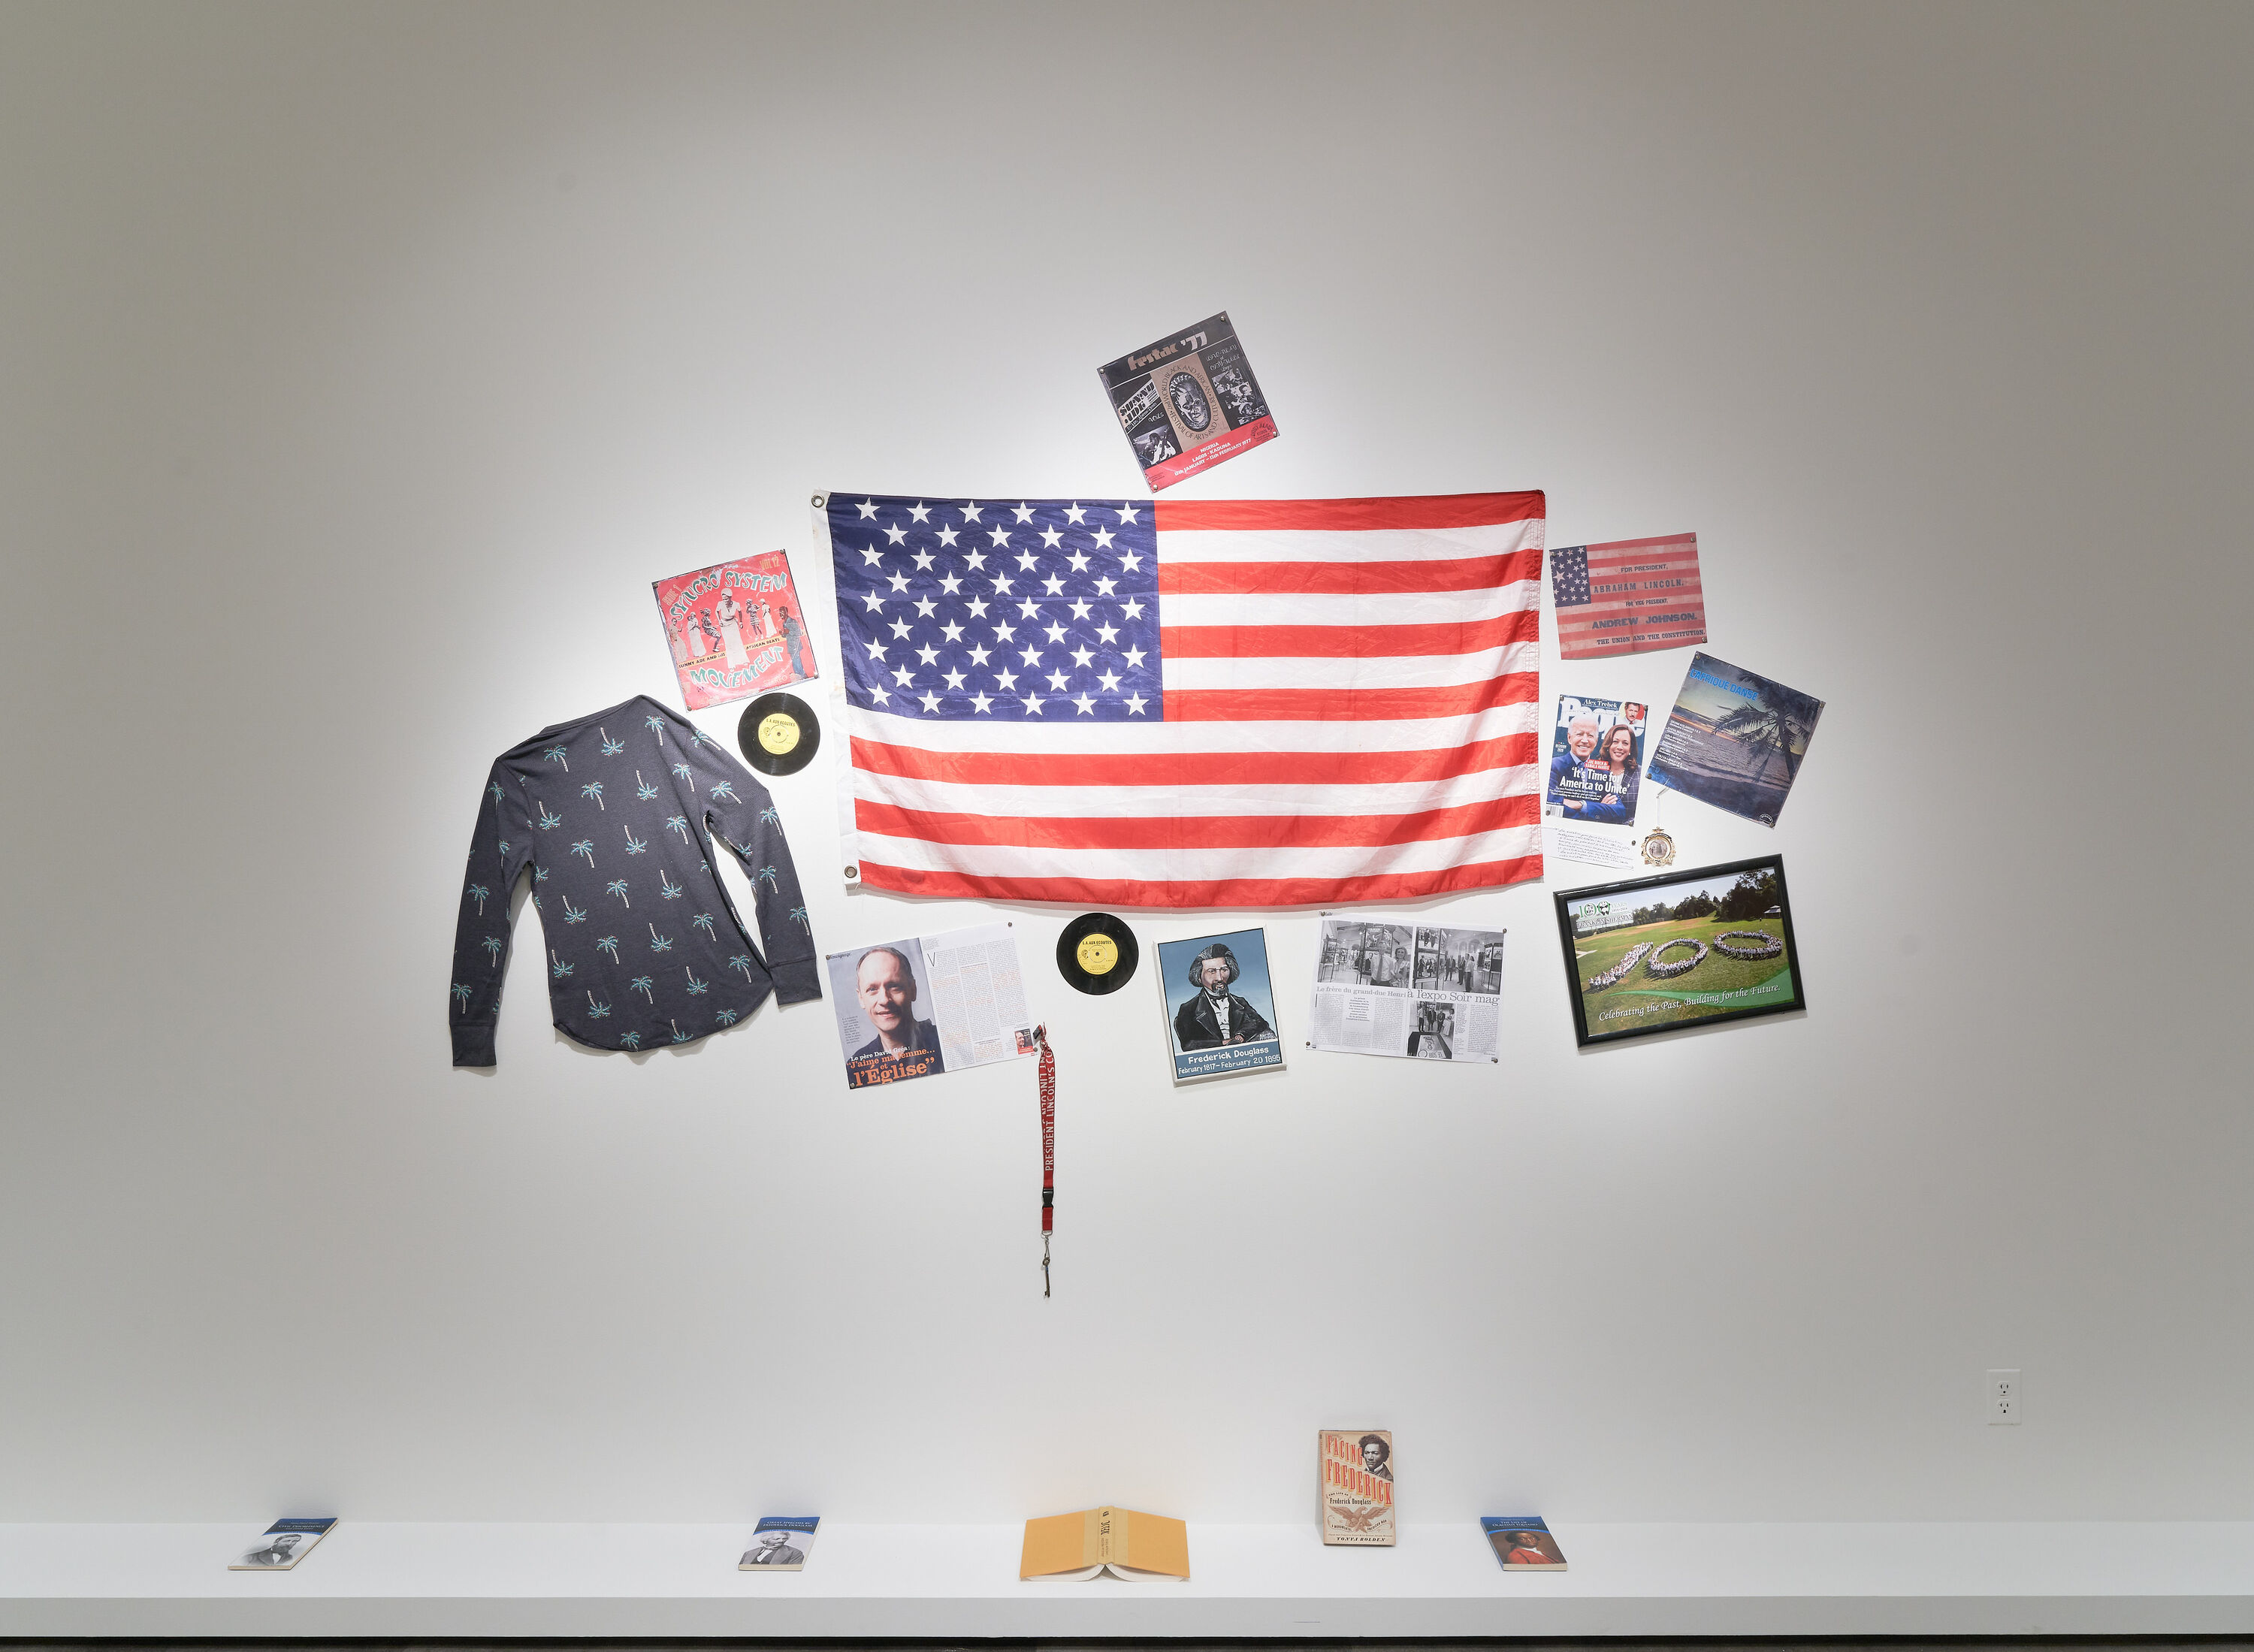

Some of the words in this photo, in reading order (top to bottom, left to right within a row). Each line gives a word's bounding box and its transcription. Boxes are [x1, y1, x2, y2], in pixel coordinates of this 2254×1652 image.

[1164, 365, 1181, 378] BLACK
[1195, 373, 1211, 394] AFRICAN
[1209, 396, 1218, 421] CULTURE
[1170, 412, 1186, 433] FESTIVAL
[1208, 422, 1217, 436] AND
[1183, 459, 1205, 473] JANUARY
[1219, 442, 1242, 455] FEBRUARY
[1241, 438, 1251, 448] 1977
[1192, 451, 1208, 462] LAGOS
[1209, 442, 1231, 455] KADUNA
[1200, 442, 1219, 453] NIGERIA
[771, 557, 779, 567] 12
[669, 573, 720, 621] SYNCRO
[725, 571, 787, 592] SYSTEM
[1594, 582, 1636, 593] ABRAHAM
[1644, 579, 1684, 589] LINCOLN.
[1592, 617, 1638, 630] ANDREW
[1646, 613, 1697, 624] JOHNSON.
[689, 646, 784, 688] MOVEMENT
[1690, 669, 1730, 690] L'AFRIQUE
[1730, 683, 1759, 701] DANSE
[1560, 776, 1594, 790] America
[1595, 782, 1604, 791] to
[1588, 769, 1607, 782] Time
[1606, 912, 1633, 924] SHERMAN
[927, 952, 935, 967] V
[1326, 986, 1342, 994] frère
[1353, 989, 1386, 997] grand-duc
[1407, 988, 1413, 998] à
[1417, 989, 1447, 1004] l'expo
[1449, 992, 1472, 1002] Soir
[1475, 996, 1500, 1006] mag
[1598, 1005, 1645, 1022] Celebrating
[1647, 1003, 1660, 1013] the
[1661, 999, 1682, 1011] Past,
[1684, 991, 1720, 1007] Building
[1718, 988, 1734, 1004] for
[1735, 987, 1748, 998] the
[1750, 982, 1780, 996] Future.
[859, 1052, 873, 1061] père
[1178, 1066, 1203, 1075] February
[1221, 1060, 1251, 1068] February
[1265, 1055, 1280, 1063] 1895
[1188, 1052, 1231, 1064] Frederick
[1234, 1047, 1269, 1058] Douglass
[1046, 1067, 1055, 1117] LINCOLN'S
[1045, 1121, 1054, 1171] PRESIDENT
[1327, 1435, 1363, 1466] FACING
[1327, 1459, 1392, 1505] FREDERICK
